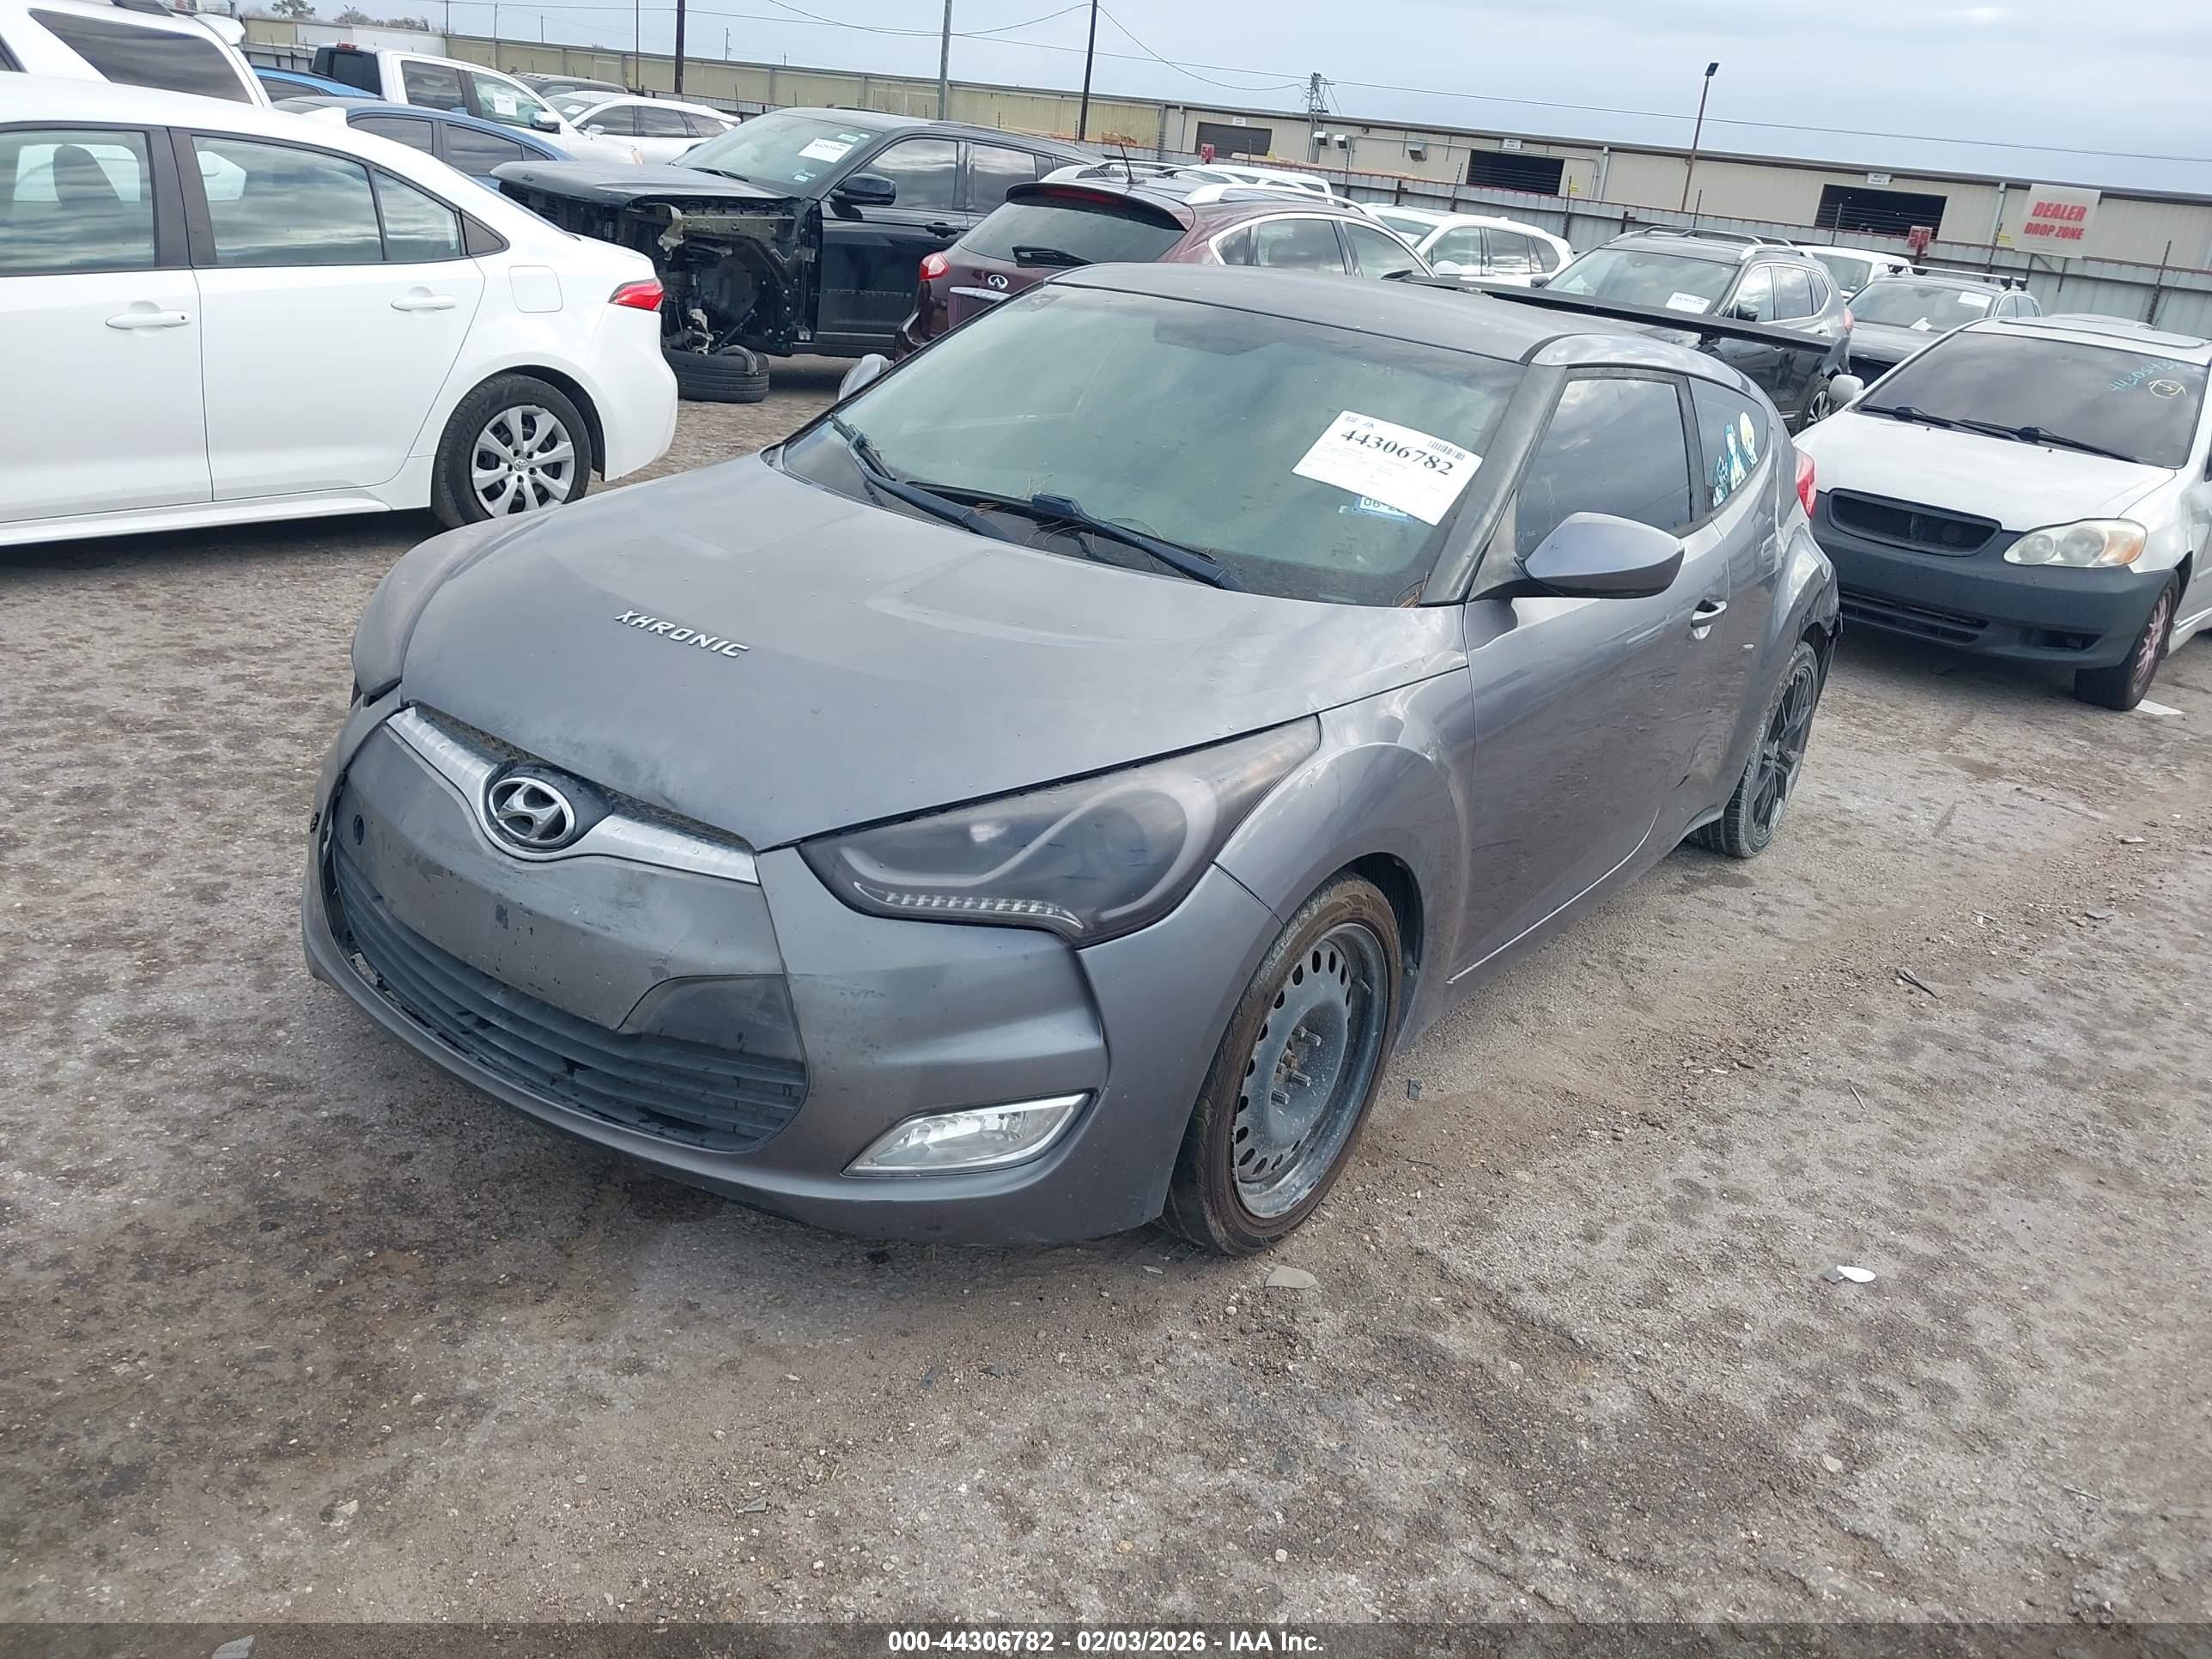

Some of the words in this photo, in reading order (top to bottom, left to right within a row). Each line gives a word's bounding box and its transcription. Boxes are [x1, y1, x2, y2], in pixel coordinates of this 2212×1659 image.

[2032, 201, 2087, 222] DEALER
[2024, 222, 2056, 237] DROP
[2054, 225, 2085, 240] ZONE
[1340, 429, 1454, 476] 44306782
[614, 610, 750, 658] XHRONIC
